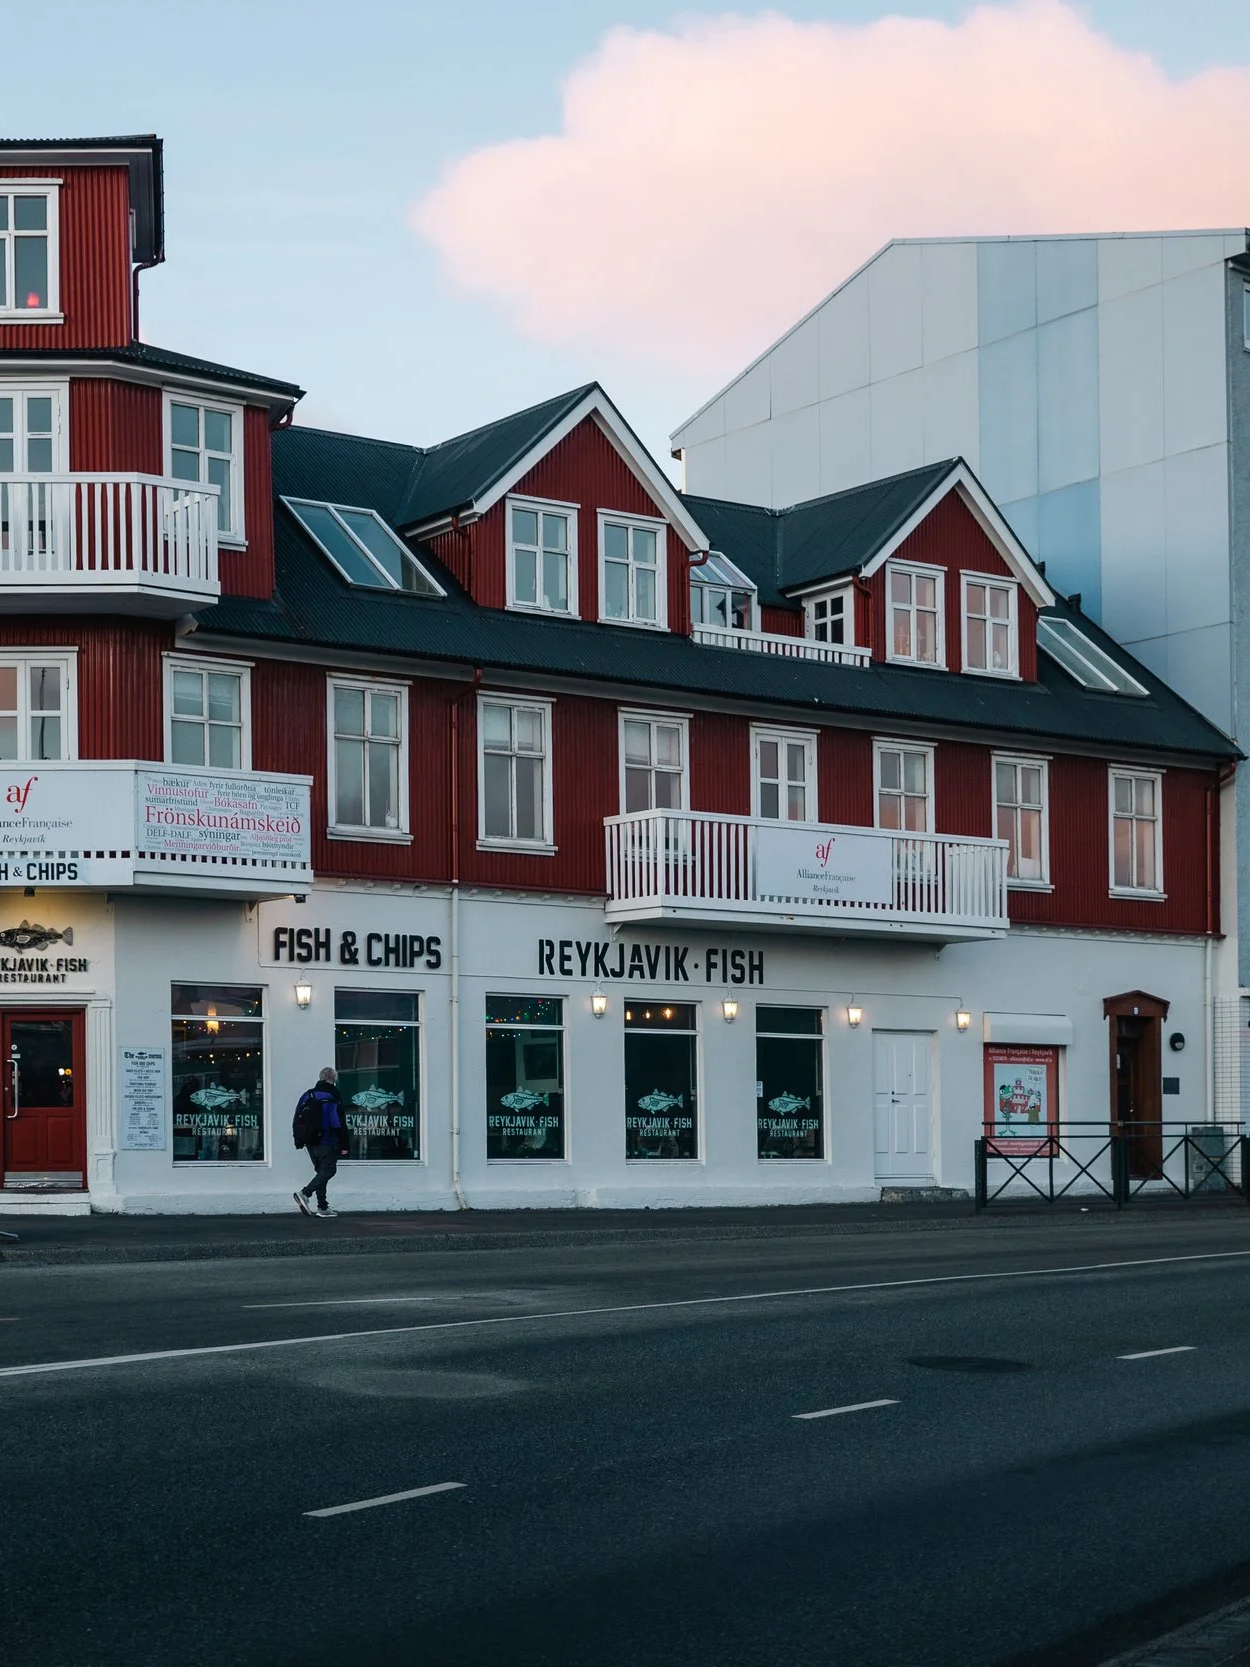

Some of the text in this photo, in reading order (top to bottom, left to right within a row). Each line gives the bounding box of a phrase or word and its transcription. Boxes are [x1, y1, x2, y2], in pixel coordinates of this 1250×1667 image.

[162, 777, 190, 788] bækur
[210, 780, 224, 790] fyrir
[6, 776, 39, 813] af
[147, 783, 209, 799] Vinnustofur
[214, 797, 258, 810] Bókasafn
[285, 801, 300, 810] TCF
[145, 806, 301, 834] Frönskunámskeið
[146, 828, 192, 839] DELF-DALF
[198, 828, 241, 843] sýningar
[164, 839, 240, 852] Menningarviðburðir
[815, 837, 836, 868] af
[13, 867, 23, 877] &
[26, 862, 78, 881] CHIPS
[273, 926, 442, 969] FISH & CHIPS
[56, 958, 88, 972] FISH
[538, 938, 764, 985] REYKJAVIK FISH
[176, 1113, 257, 1126] REYKJAVIK FISH
[345, 1114, 414, 1127] EYKJAVIK FISH
[489, 1115, 559, 1127] REYKJAVIK FISH
[627, 1117, 692, 1128] REYKJAVIK FISH
[758, 1118, 819, 1129] REYKJAVIK FISH
[353, 1128, 400, 1136] RESTAURANT
[502, 1128, 546, 1136] RESTAURANT
[639, 1129, 680, 1137] RESTAURANT
[770, 1130, 807, 1138] RESTAURANT
